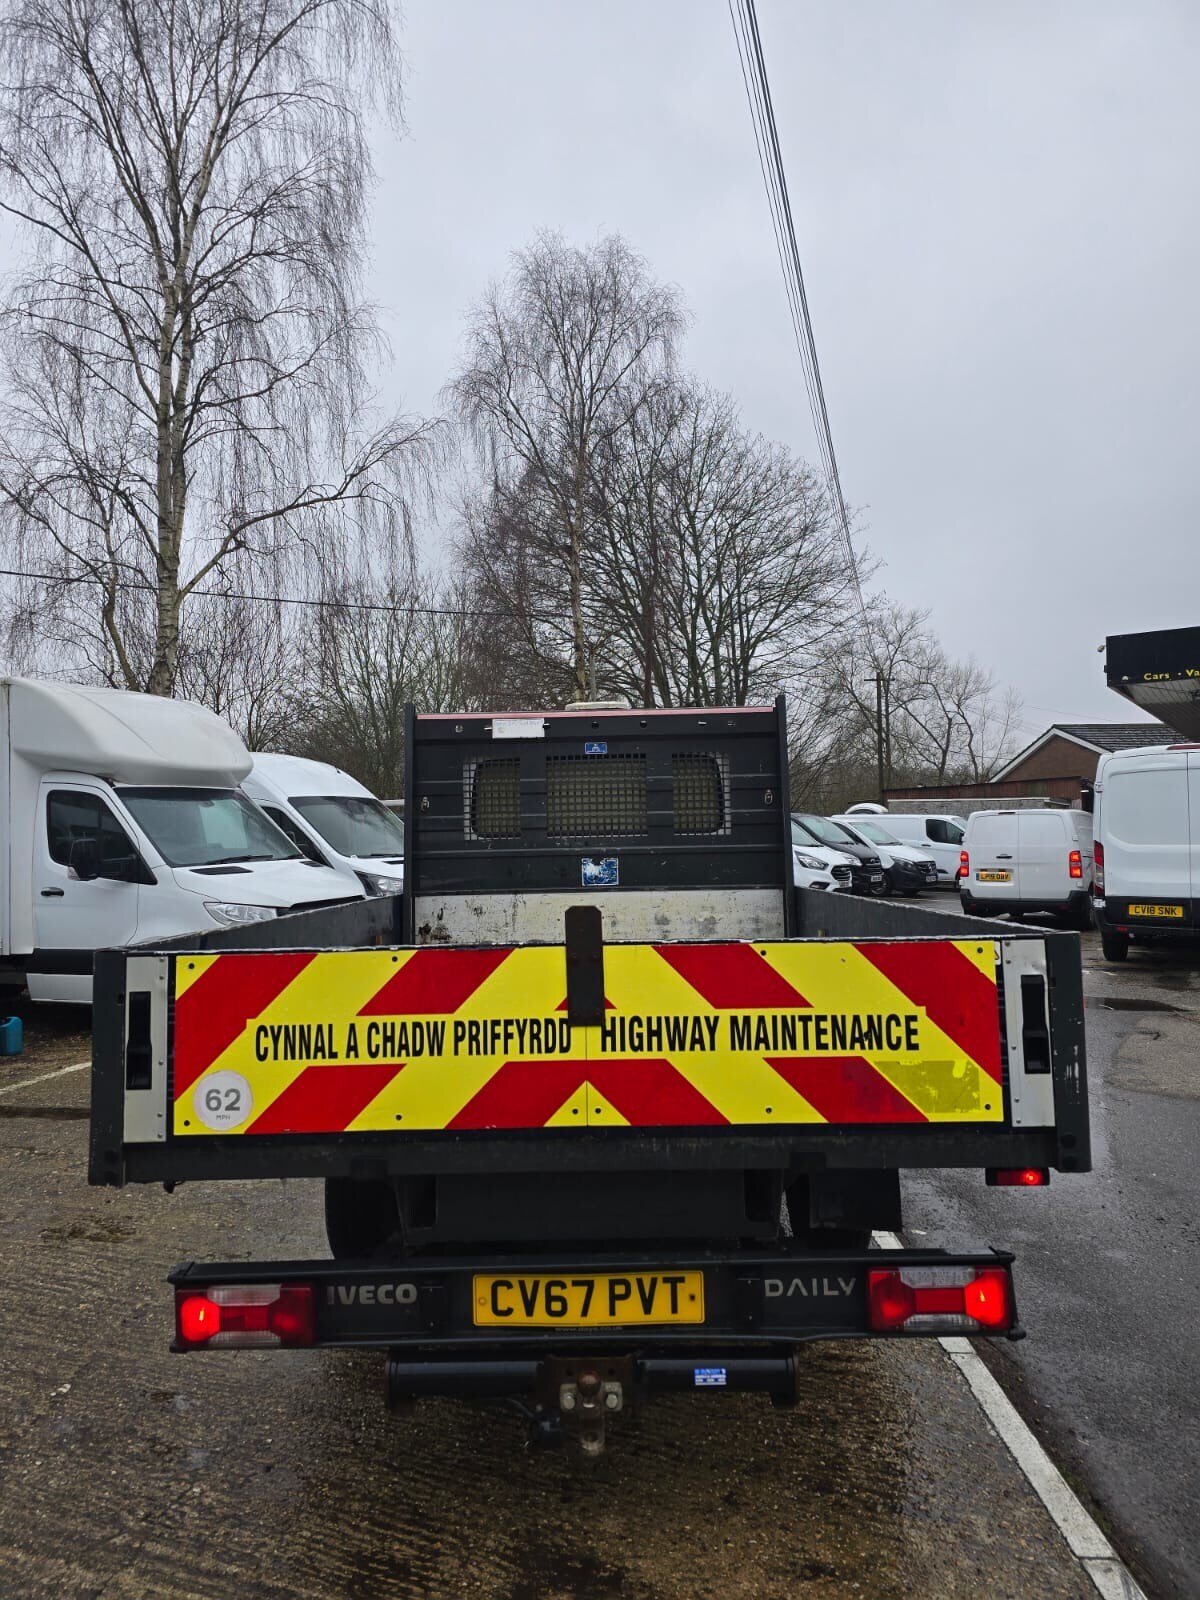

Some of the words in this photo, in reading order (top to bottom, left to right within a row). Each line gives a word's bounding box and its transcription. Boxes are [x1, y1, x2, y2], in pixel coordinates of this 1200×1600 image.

[1143, 672, 1170, 680] Cars
[1134, 905, 1155, 914] CV18
[1158, 906, 1177, 916] SNK
[255, 1024, 338, 1062] CYNNAL
[346, 1022, 360, 1059] A
[366, 1020, 446, 1058] CHADW
[453, 1017, 572, 1056] PRIFFYRDD
[600, 1015, 720, 1053] HIGHWAY
[729, 1013, 920, 1052] MAINTENANCE
[205, 1088, 241, 1112] 62
[327, 1283, 418, 1305] IVECO
[490, 1279, 595, 1318] CV67
[608, 1276, 686, 1317] PVT
[764, 1278, 857, 1297] DAILY
